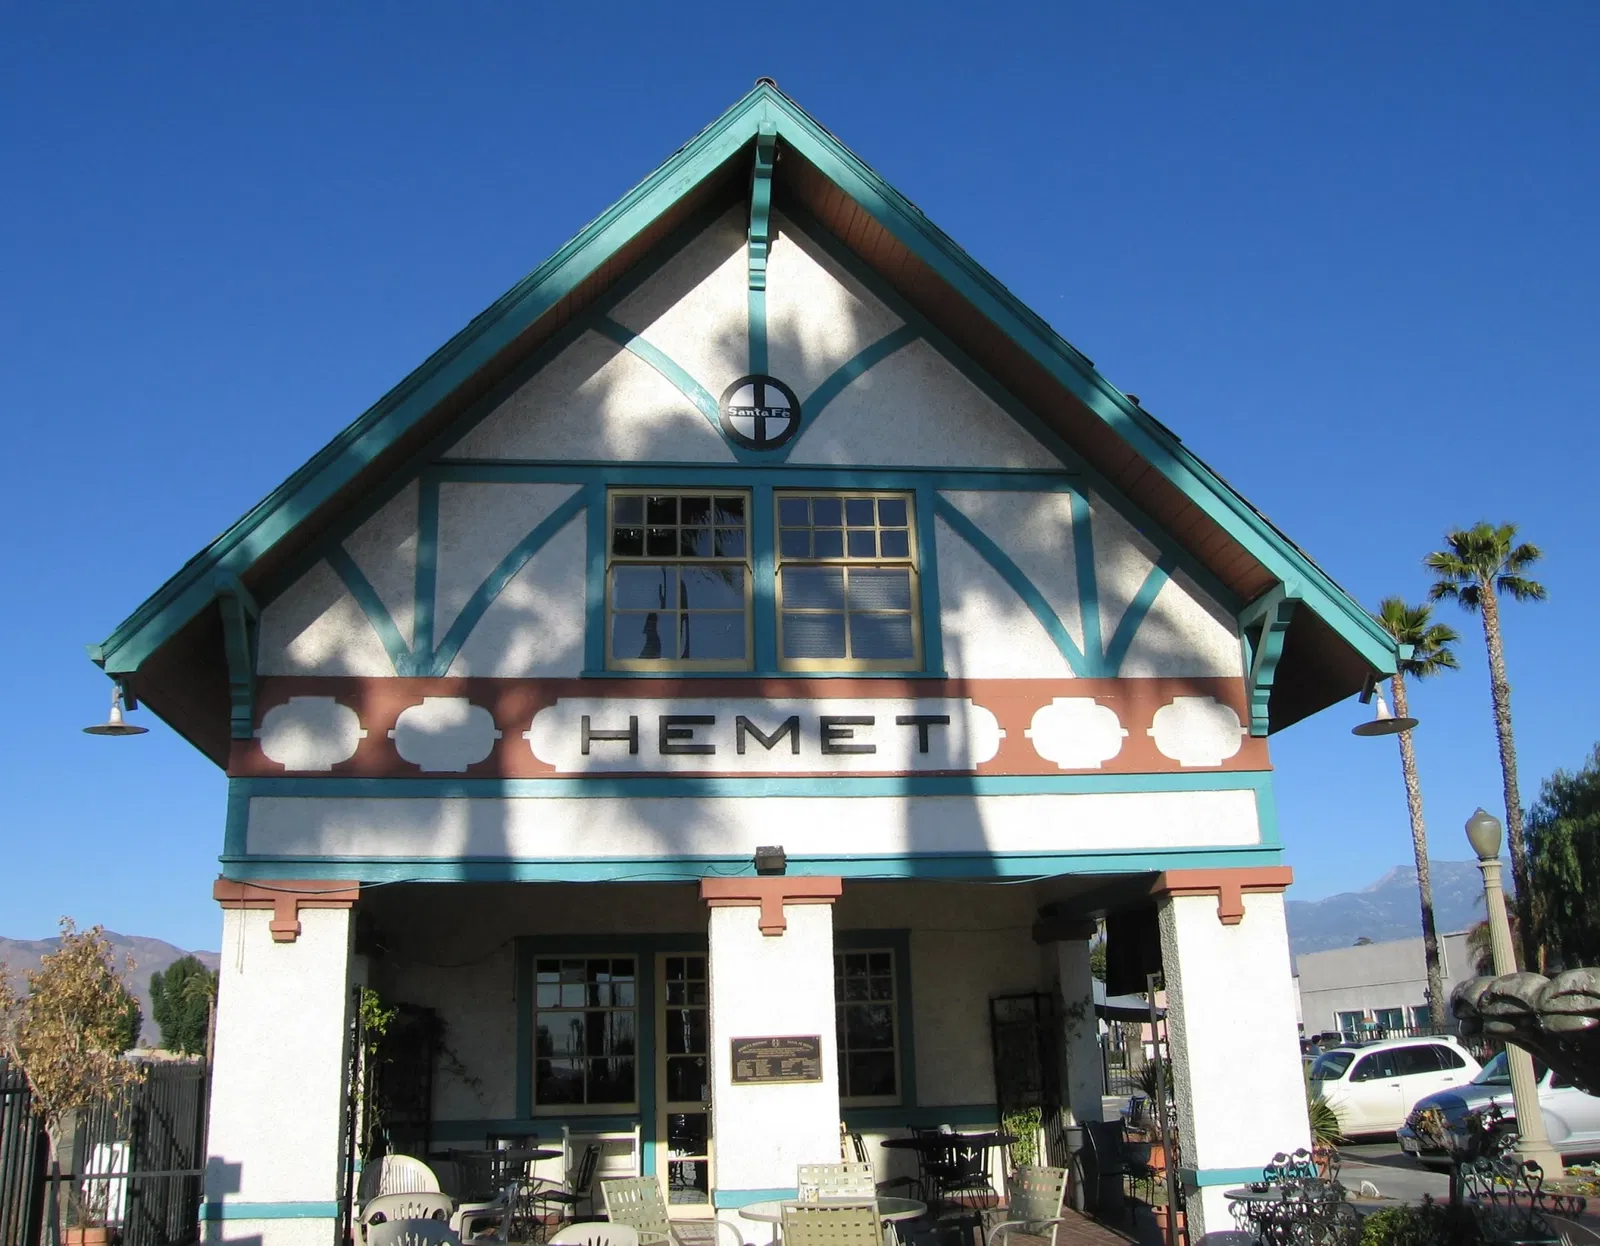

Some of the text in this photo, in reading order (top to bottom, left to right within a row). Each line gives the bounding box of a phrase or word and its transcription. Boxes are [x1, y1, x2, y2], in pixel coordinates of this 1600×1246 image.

[728, 407, 790, 418] Santa Fe
[581, 715, 950, 755] HEMET
